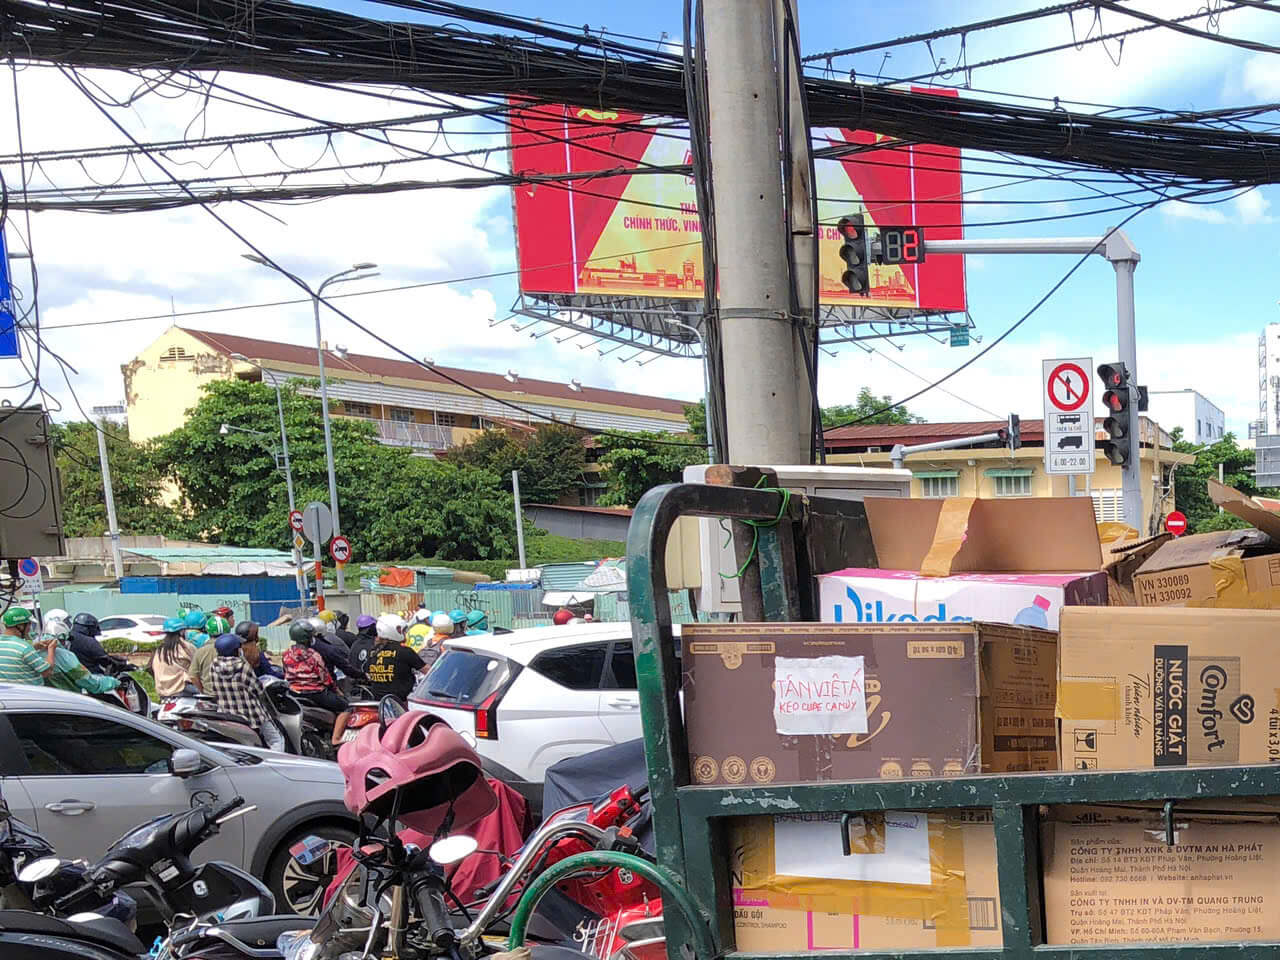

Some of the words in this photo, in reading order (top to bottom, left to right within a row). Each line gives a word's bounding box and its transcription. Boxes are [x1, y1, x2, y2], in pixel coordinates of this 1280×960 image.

[623, 214, 652, 230] CHÍNH
[1141, 580, 1155, 590] VN
[1157, 574, 1190, 589] 330089
[1143, 592, 1157, 604] TH
[1159, 587, 1192, 602] 330092
[1168, 659, 1186, 710] NƯỚC
[1197, 664, 1228, 753] Comfort
[1165, 714, 1187, 755] GIẶT
[1267, 739, 1280, 755] 3,0
[1070, 846, 1098, 856] CÔNG
[1100, 847, 1113, 855] TY
[1144, 846, 1164, 854] XNK
[1175, 845, 1203, 853] DVTM
[1205, 845, 1219, 853] AN
[1221, 842, 1235, 853] HÀ
[1237, 841, 1264, 852] PHÁT
[1070, 897, 1096, 907] CÔNG
[1112, 898, 1137, 906] TNHH
[1152, 896, 1164, 905] VÀ
[1196, 896, 1229, 905] QUANG
[1231, 895, 1264, 904] TRUNG
